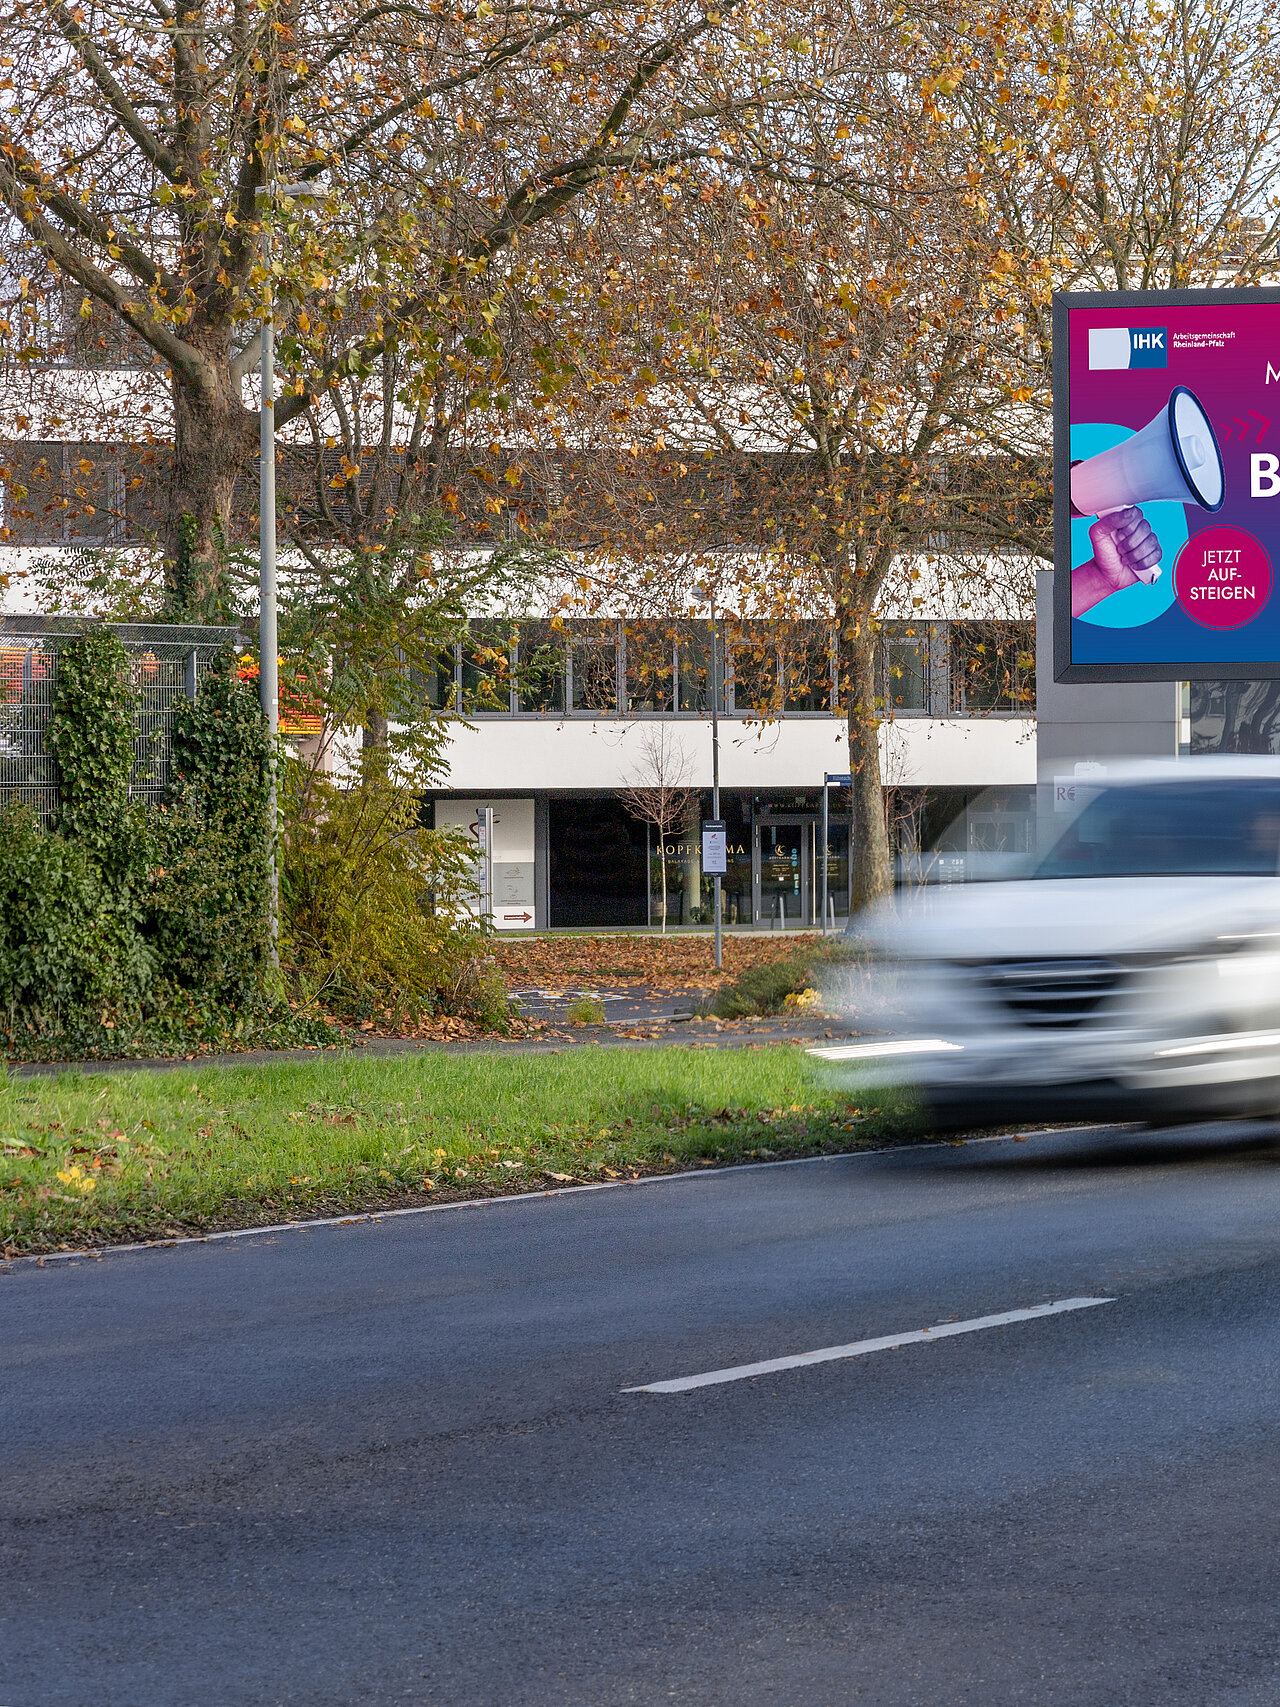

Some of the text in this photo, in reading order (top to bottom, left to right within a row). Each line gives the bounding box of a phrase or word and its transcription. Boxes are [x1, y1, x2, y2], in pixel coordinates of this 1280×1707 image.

[1134, 333, 1164, 349] IHK
[1173, 331, 1236, 341] Arbeitsgemeinschaft
[1173, 339, 1225, 348] Rheinland-Pfalz
[1201, 550, 1242, 567] JETZT
[1207, 568, 1242, 582] AUF-
[1189, 585, 1256, 601] STEIGEN
[656, 844, 745, 854] KOPFKMA
